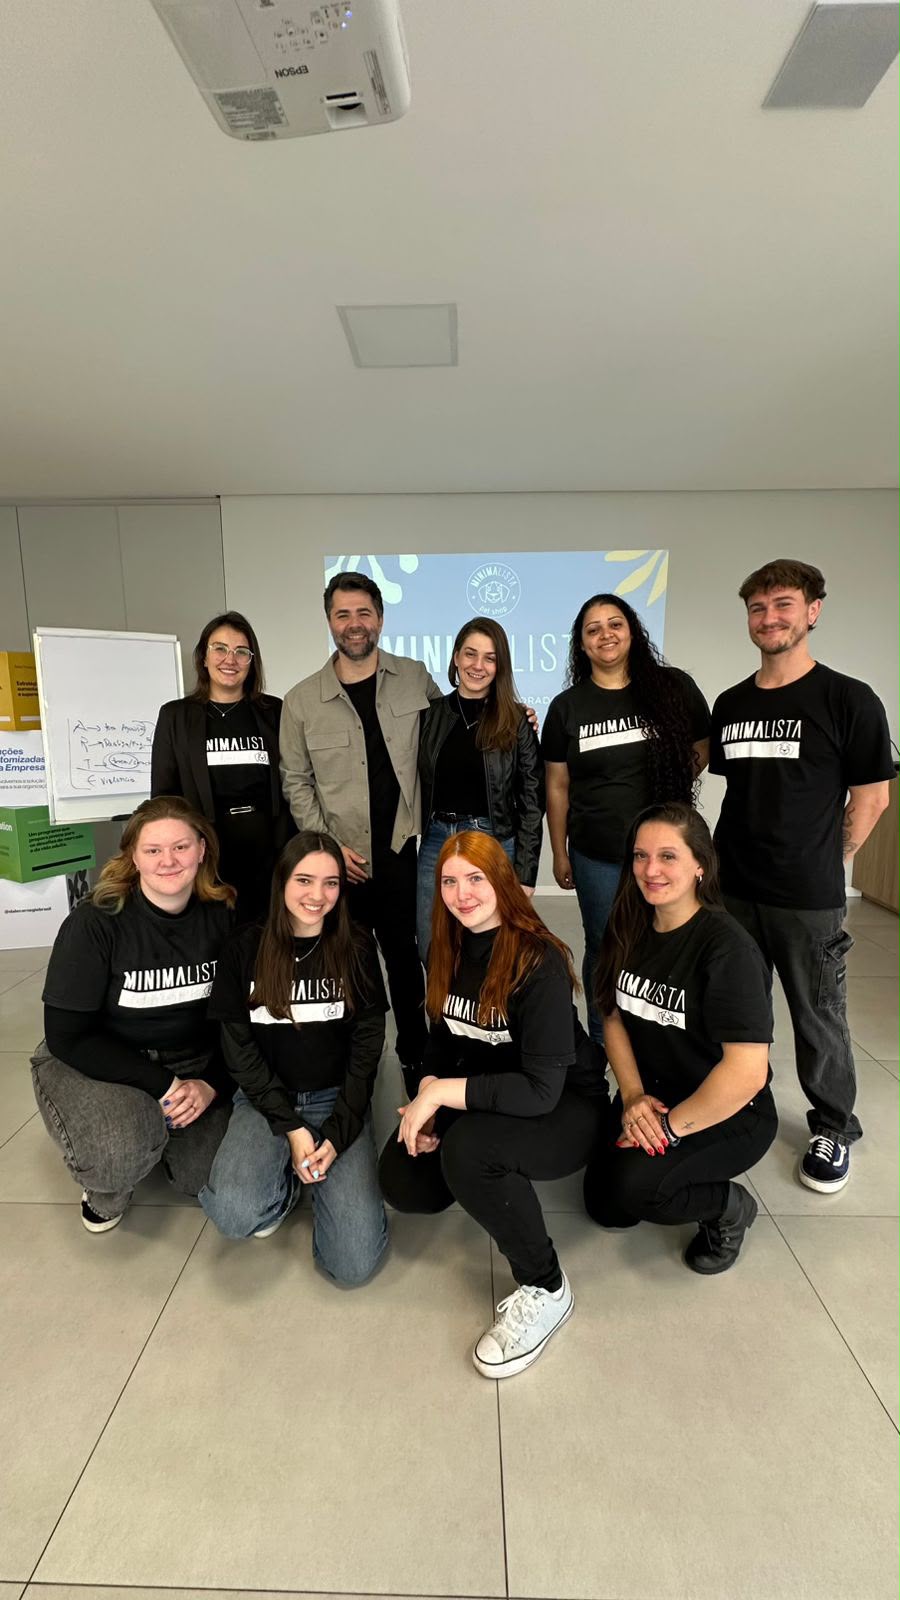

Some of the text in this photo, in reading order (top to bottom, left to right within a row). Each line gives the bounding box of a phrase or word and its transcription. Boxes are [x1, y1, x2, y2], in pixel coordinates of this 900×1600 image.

[275, 64, 309, 79] EPSON
[470, 566, 517, 588] MINIMALISTA
[580, 715, 640, 739] MINIMALI
[721, 719, 802, 743] MINIMALISTA
[0, 748, 24, 756] ções
[206, 736, 265, 751] NIMALIST
[123, 960, 218, 991] MINIMALIST
[618, 969, 685, 1012] IMALISTA
